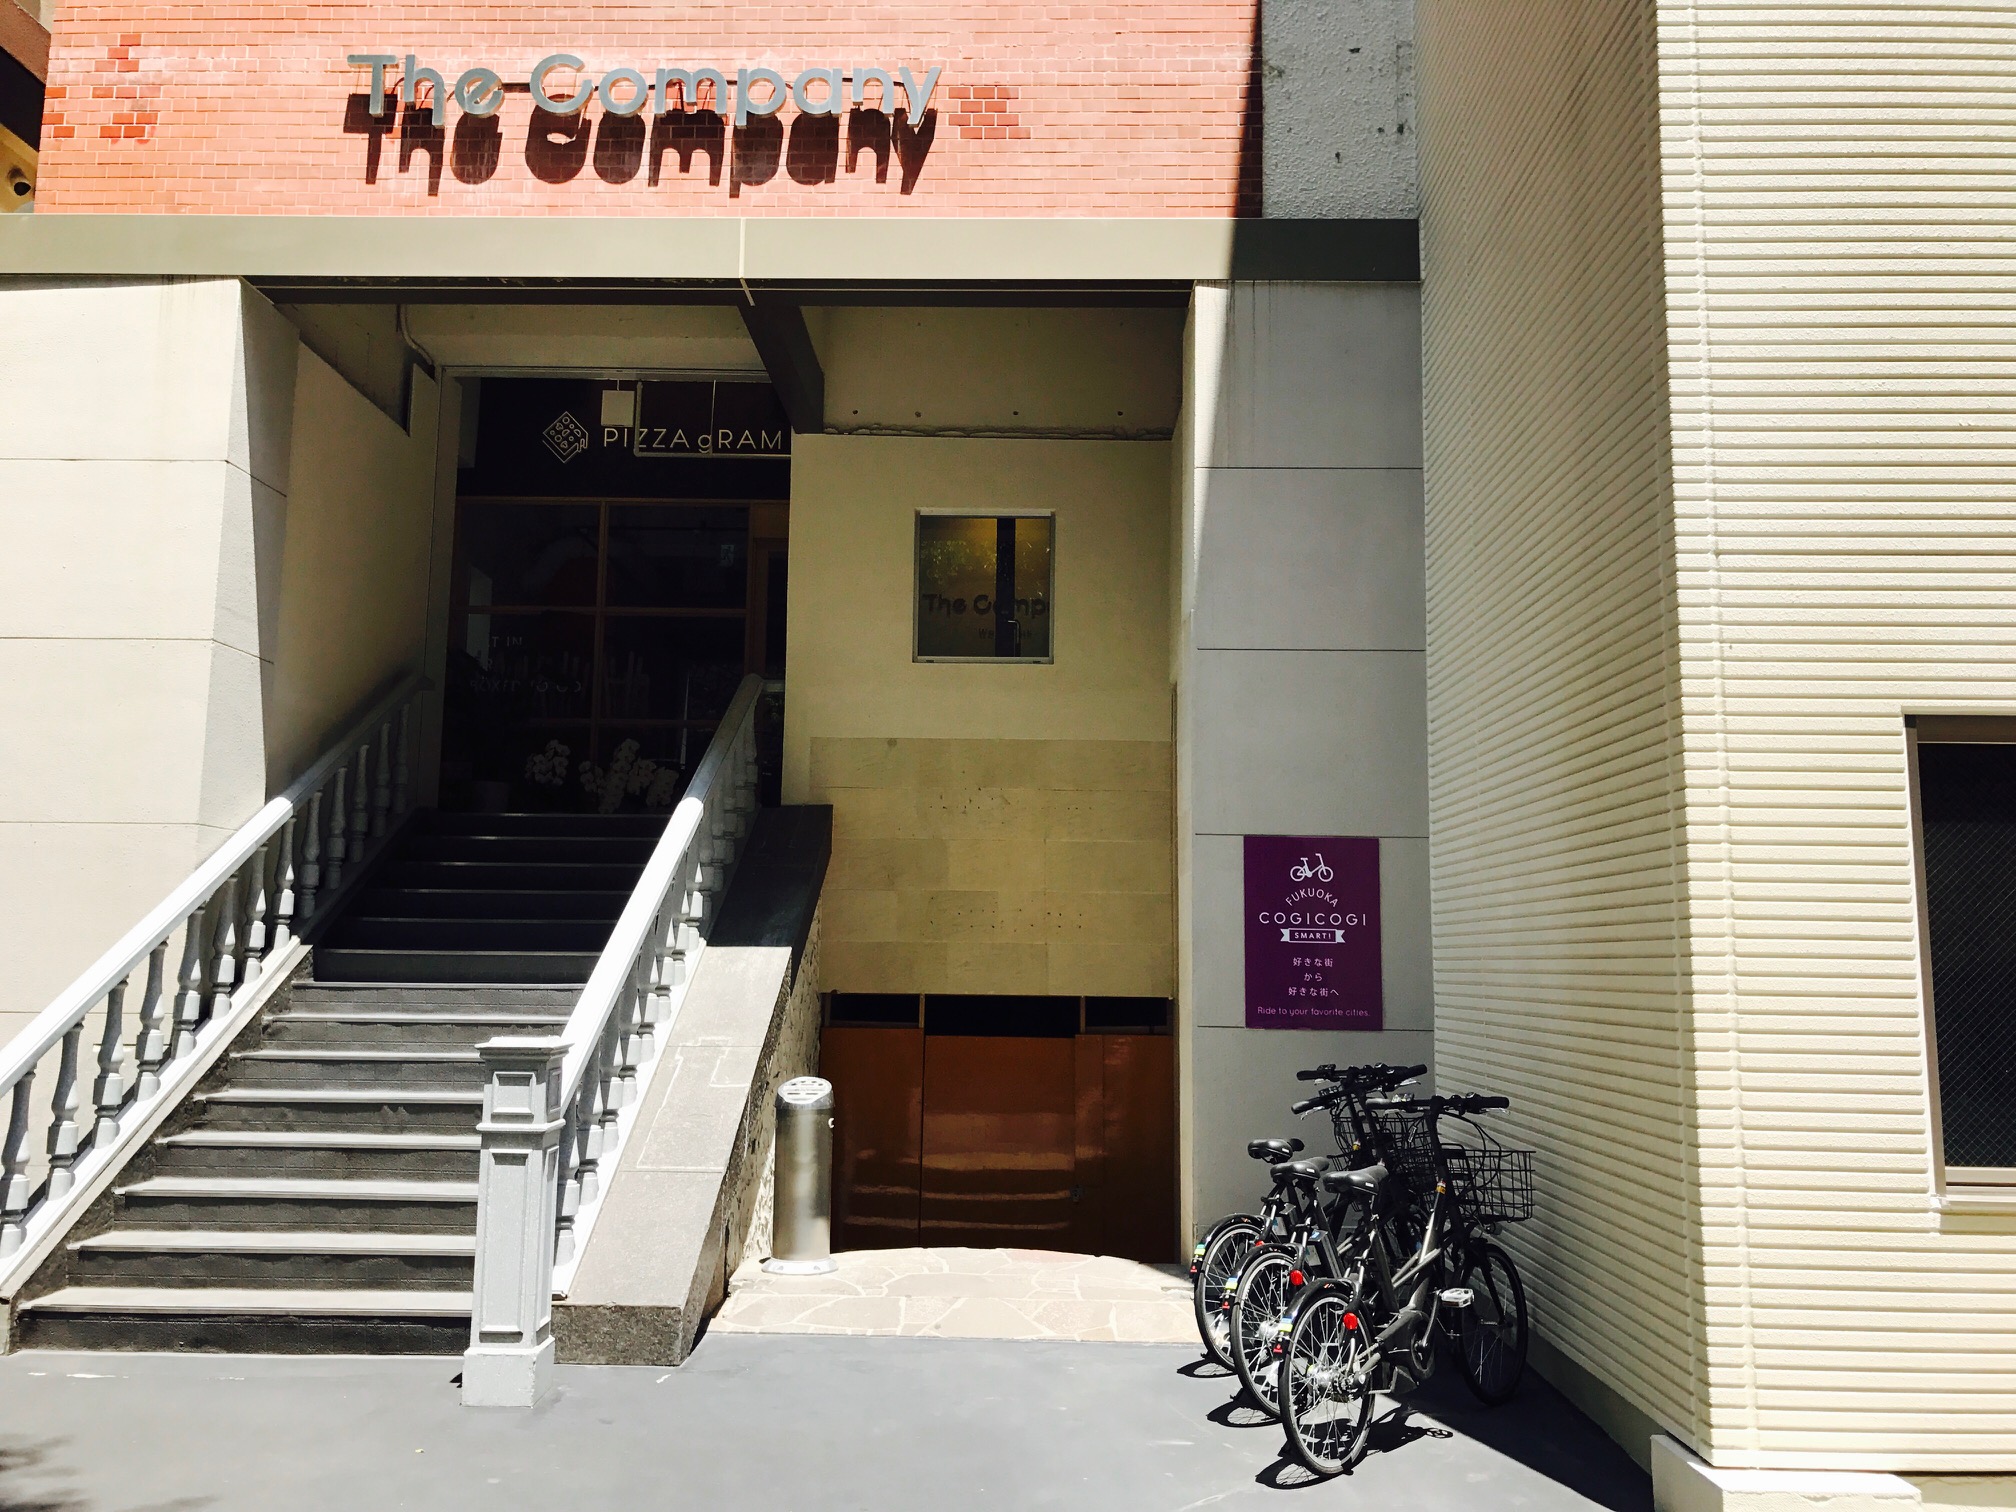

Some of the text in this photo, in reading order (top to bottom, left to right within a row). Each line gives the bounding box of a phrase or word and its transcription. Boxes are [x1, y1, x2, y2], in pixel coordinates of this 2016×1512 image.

[347, 53, 942, 129] The Company
[603, 428, 690, 448] PIZZA
[1285, 887, 1339, 907] FUKUOKA
[1258, 912, 1367, 926] COGICOGI
[1294, 931, 1332, 940] SMART!
[1292, 957, 1334, 968] 好きな街
[1303, 972, 1323, 982] から
[1288, 986, 1340, 997] 好きな街へ
[1257, 1006, 1371, 1017] Ride to your favorite cities.
